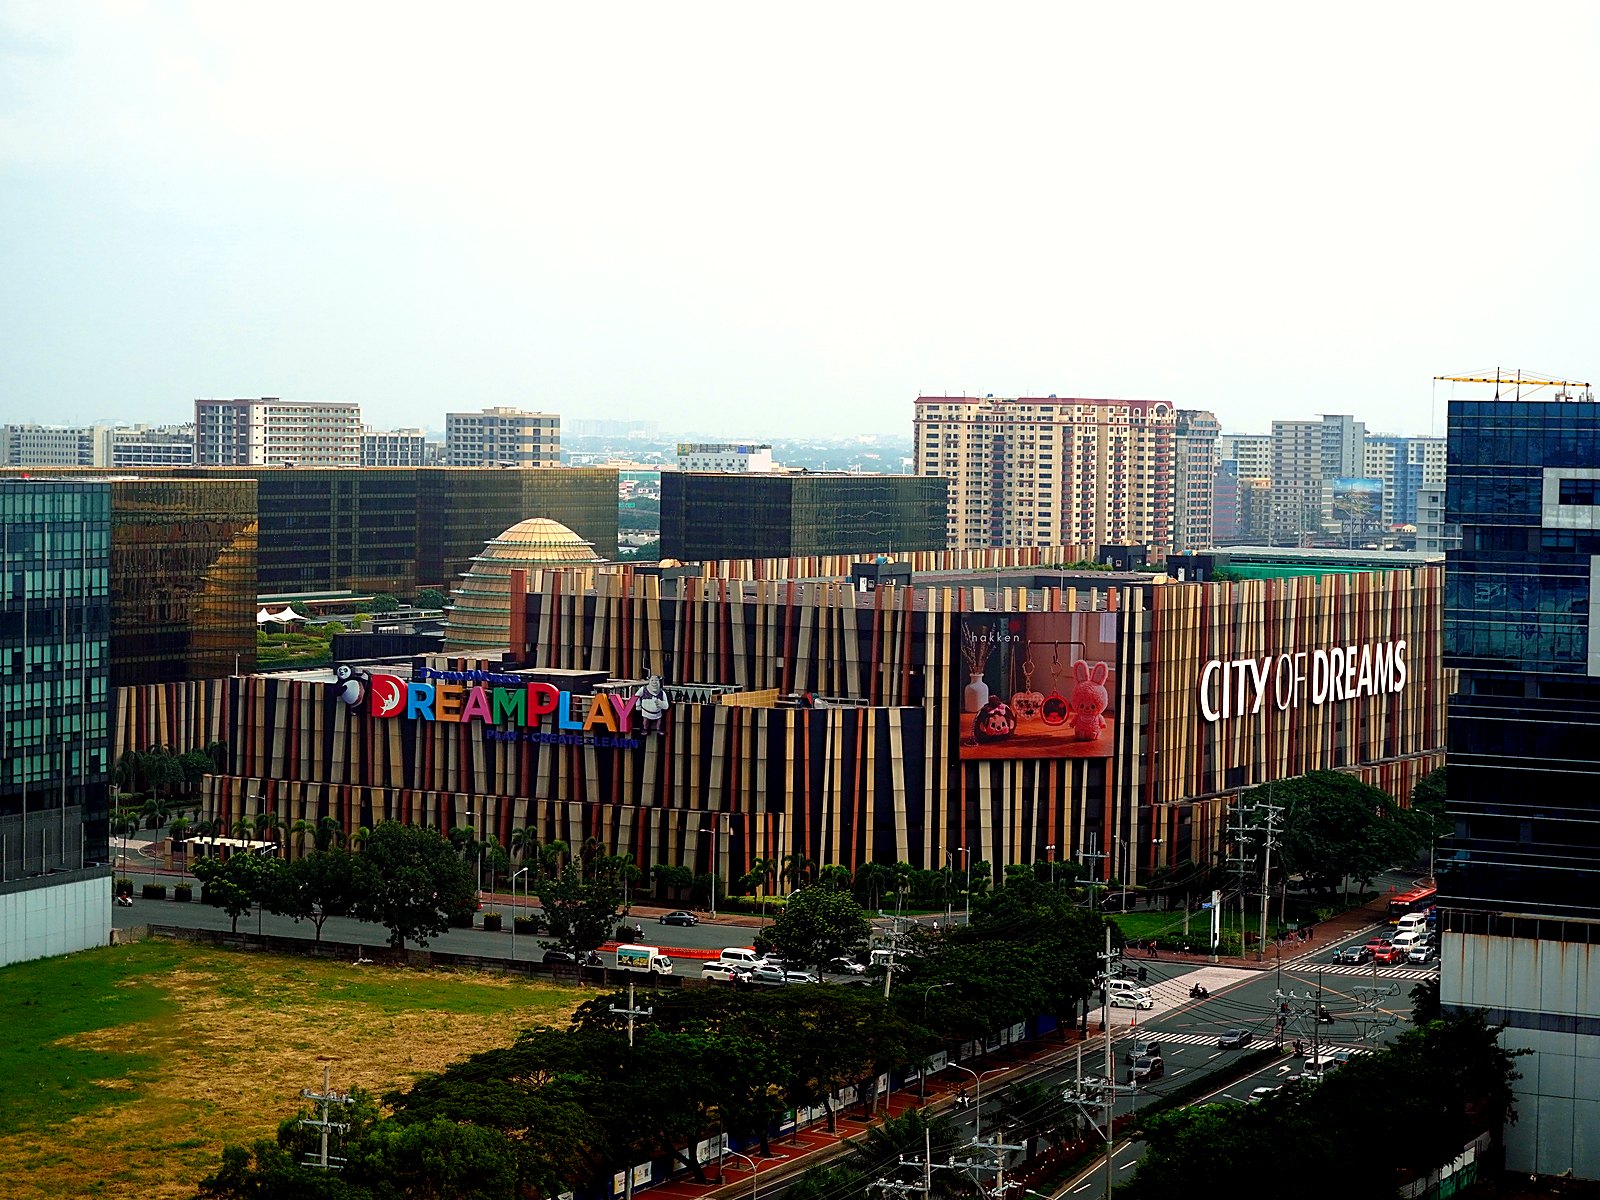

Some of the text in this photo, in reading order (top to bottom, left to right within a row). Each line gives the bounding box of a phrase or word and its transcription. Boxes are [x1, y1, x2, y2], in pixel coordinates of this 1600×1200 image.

[971, 631, 1020, 642] hakken
[1199, 640, 1407, 722] CITY OF DREAMS
[371, 674, 638, 733] DREAMPLAY
[531, 732, 583, 745] CREATE
[594, 736, 639, 749] LEARN
